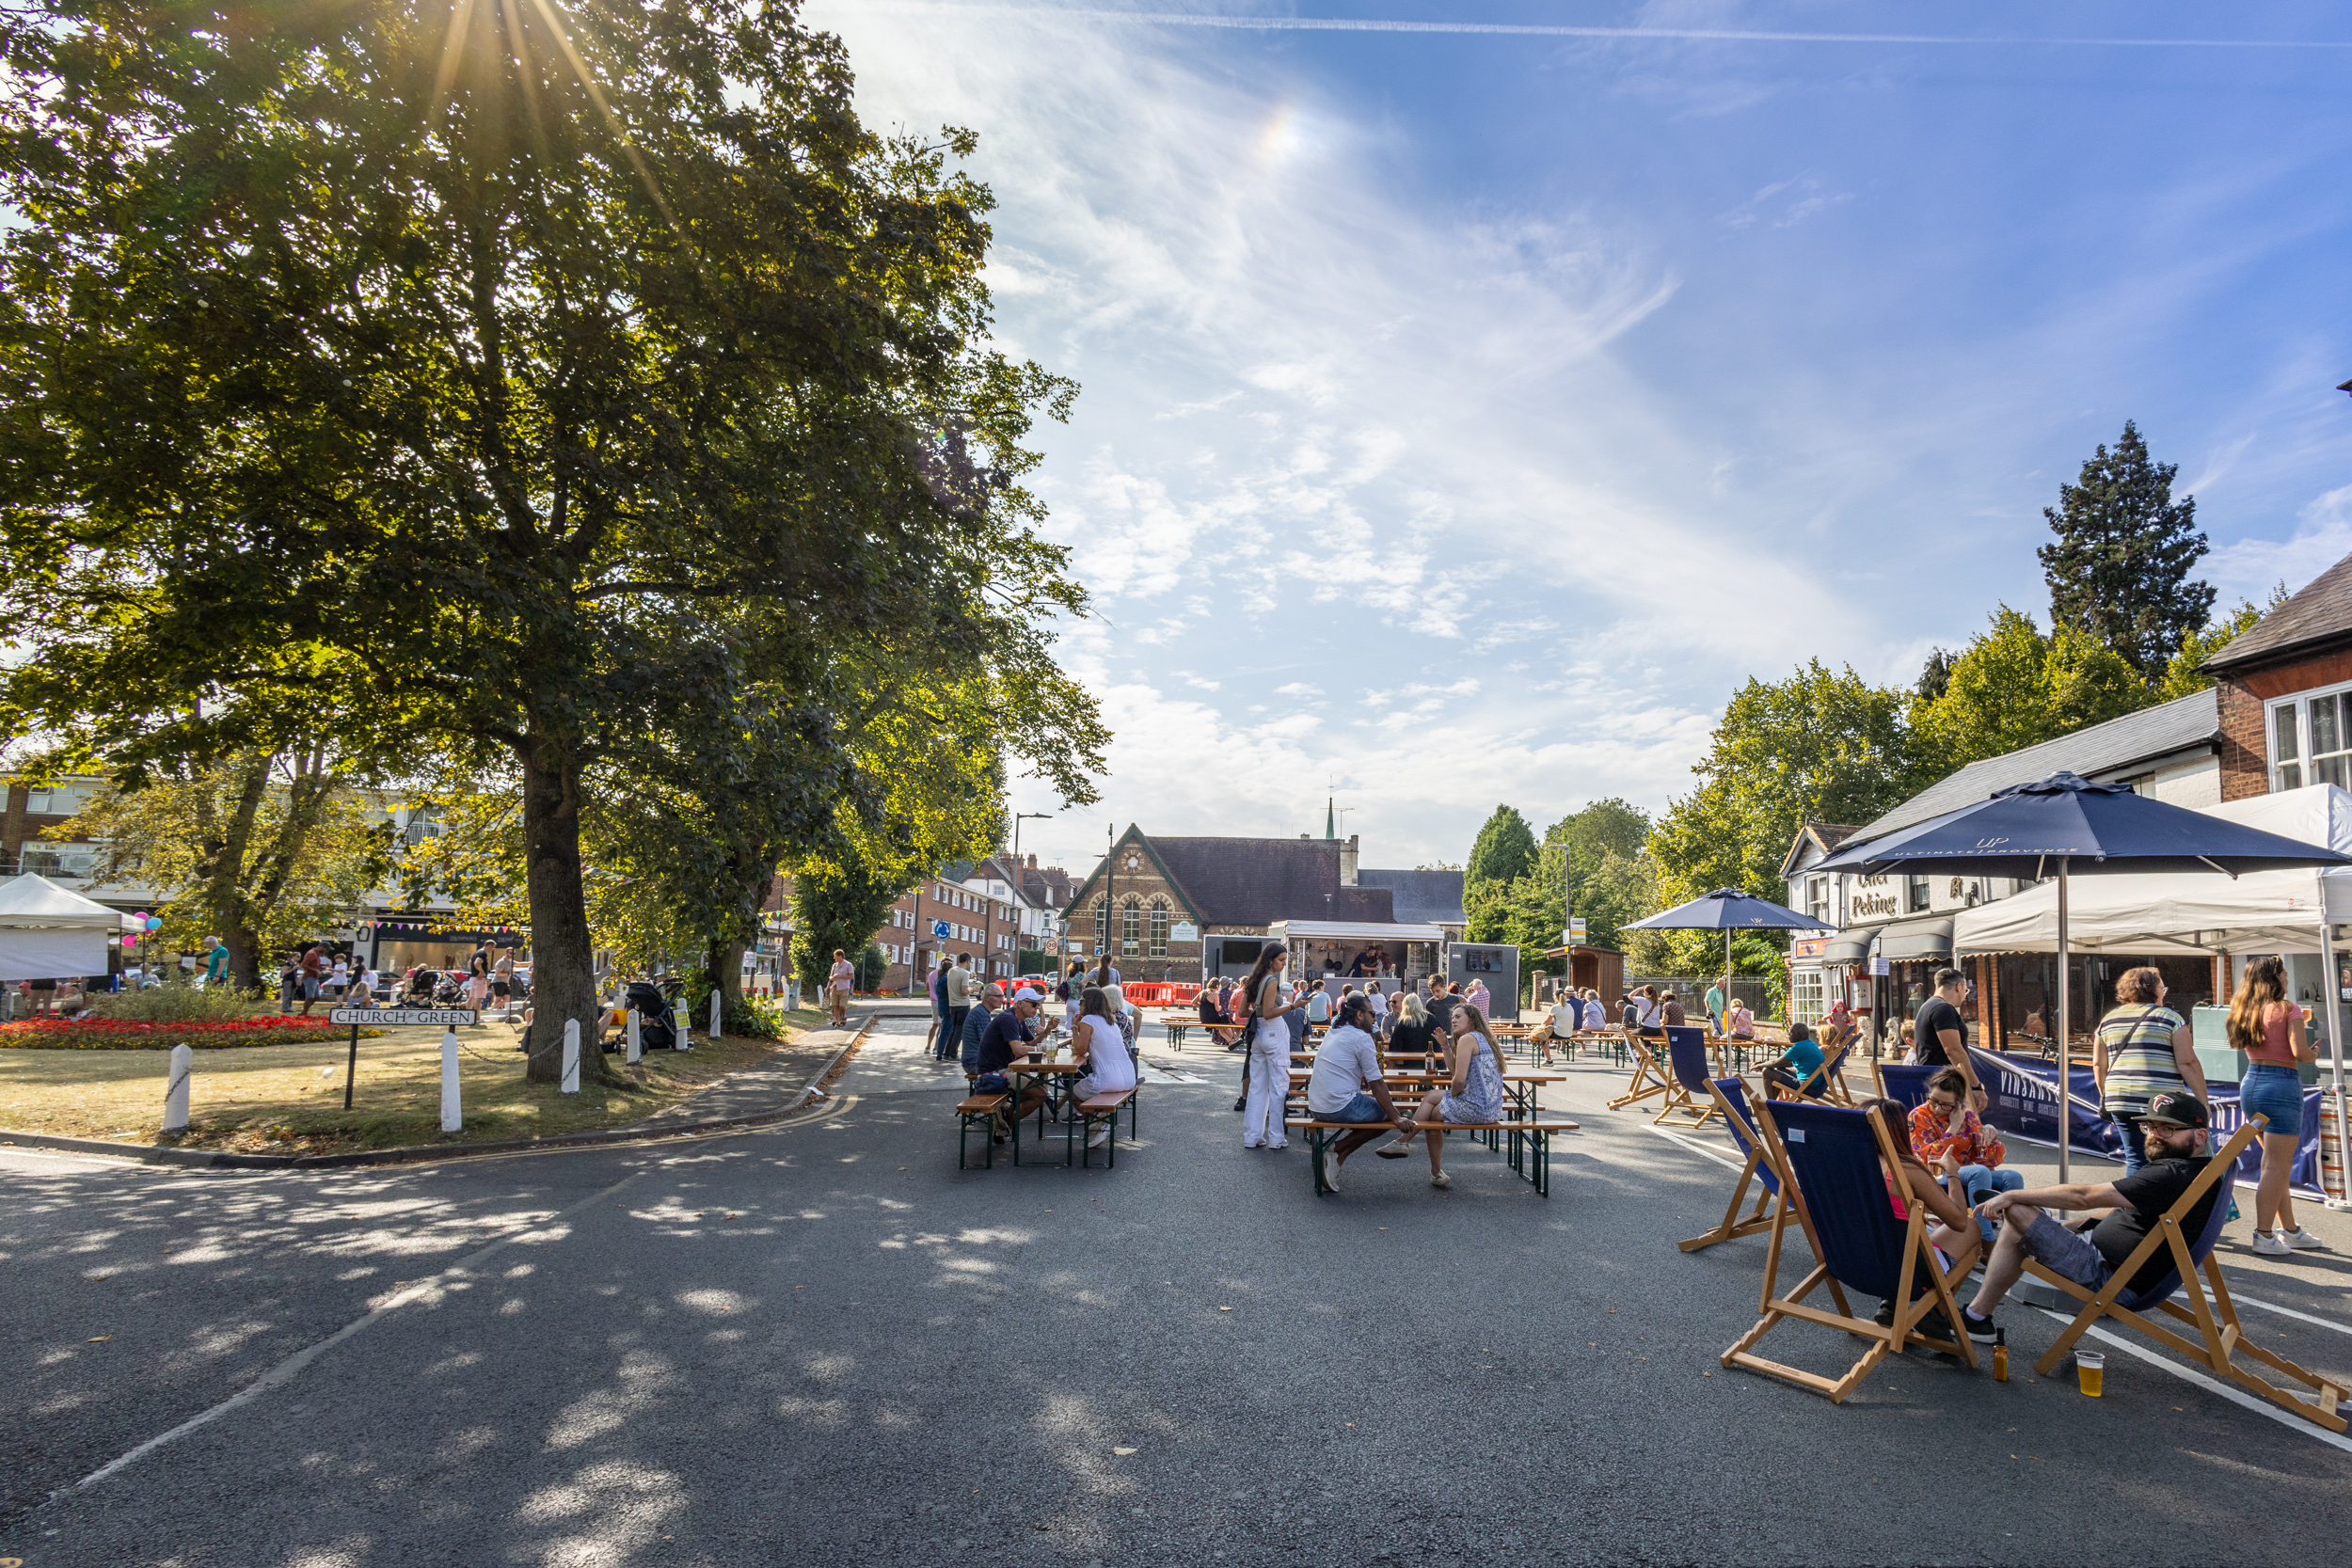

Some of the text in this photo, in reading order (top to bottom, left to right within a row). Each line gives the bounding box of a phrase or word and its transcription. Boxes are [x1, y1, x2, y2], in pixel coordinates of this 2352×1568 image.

[1975, 837, 2010, 848] UP
[1851, 892, 1897, 917] Peking
[336, 1010, 470, 1023] CHURCH GREEN
